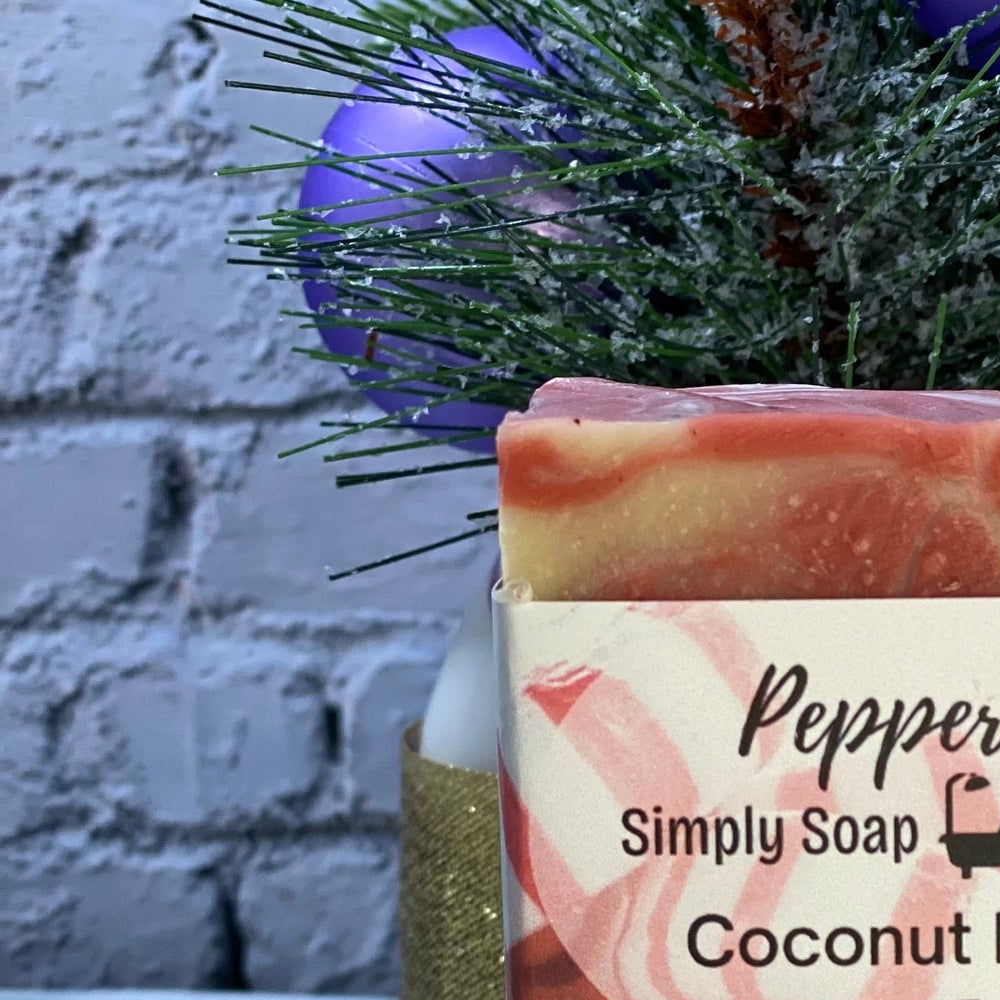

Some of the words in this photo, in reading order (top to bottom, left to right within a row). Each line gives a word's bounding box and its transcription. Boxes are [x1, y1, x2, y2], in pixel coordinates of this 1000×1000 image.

[621, 805, 784, 866] Simply
[801, 806, 918, 864] Soap
[687, 912, 971, 968] Coconut
